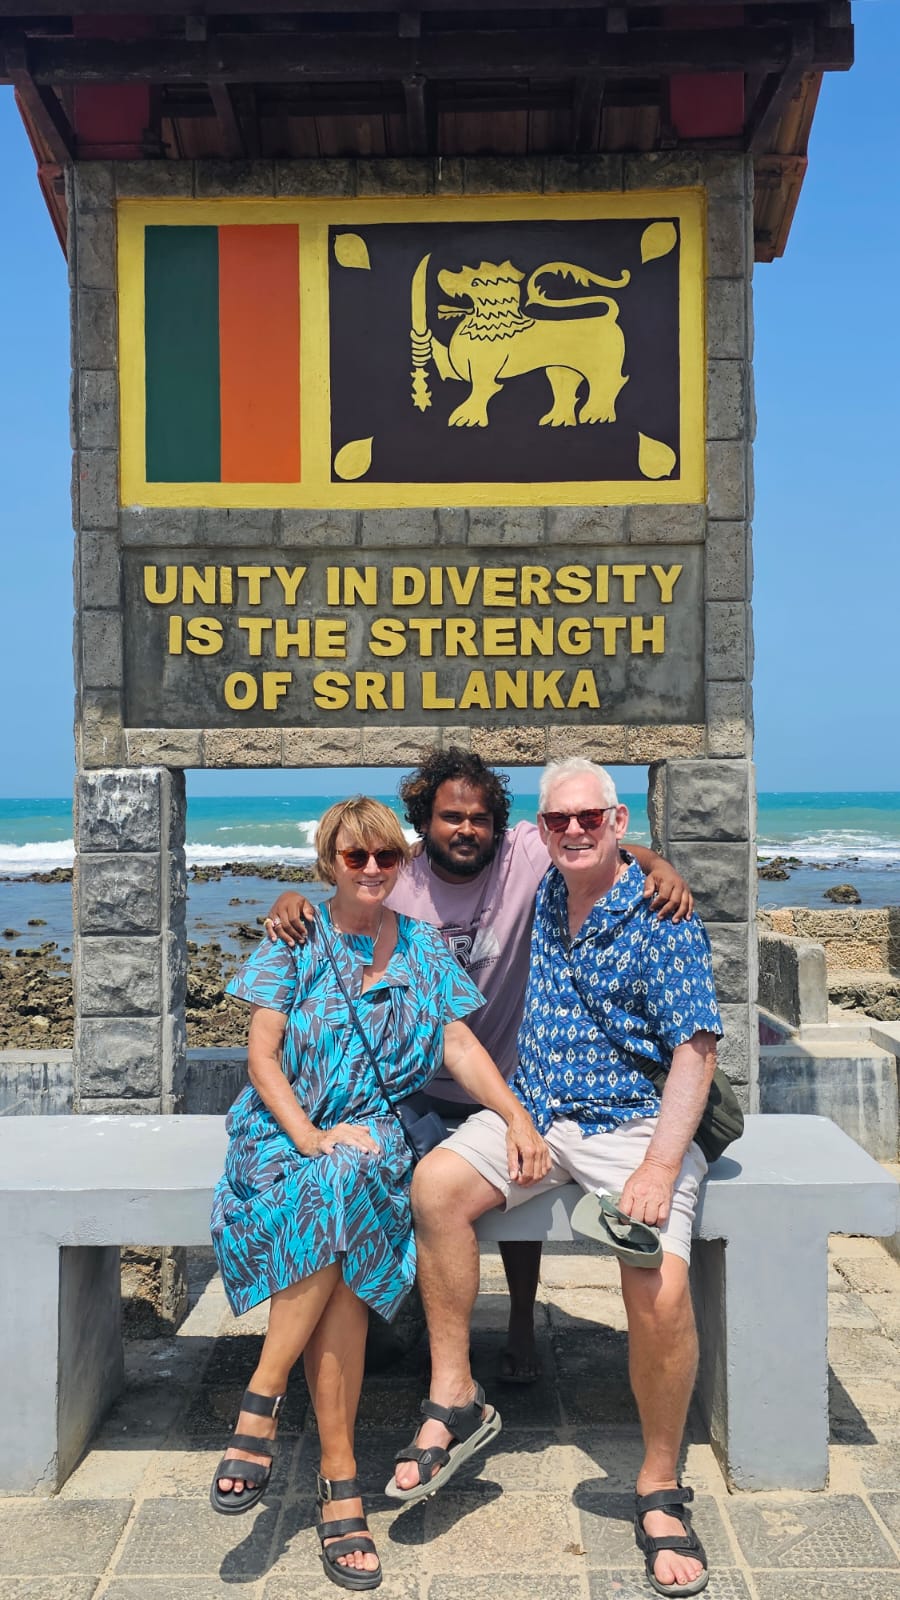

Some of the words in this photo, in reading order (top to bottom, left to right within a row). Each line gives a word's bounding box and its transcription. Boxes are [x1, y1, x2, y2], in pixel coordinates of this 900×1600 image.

[143, 566, 306, 605] UNITY
[326, 566, 378, 605] IN
[392, 564, 682, 607] DIVERSITY
[168, 615, 223, 655] IS
[238, 617, 347, 659] THE
[368, 615, 665, 658] STRENGTH
[223, 671, 291, 710] OF
[313, 671, 405, 711] SRI
[421, 669, 600, 709] LANKA
